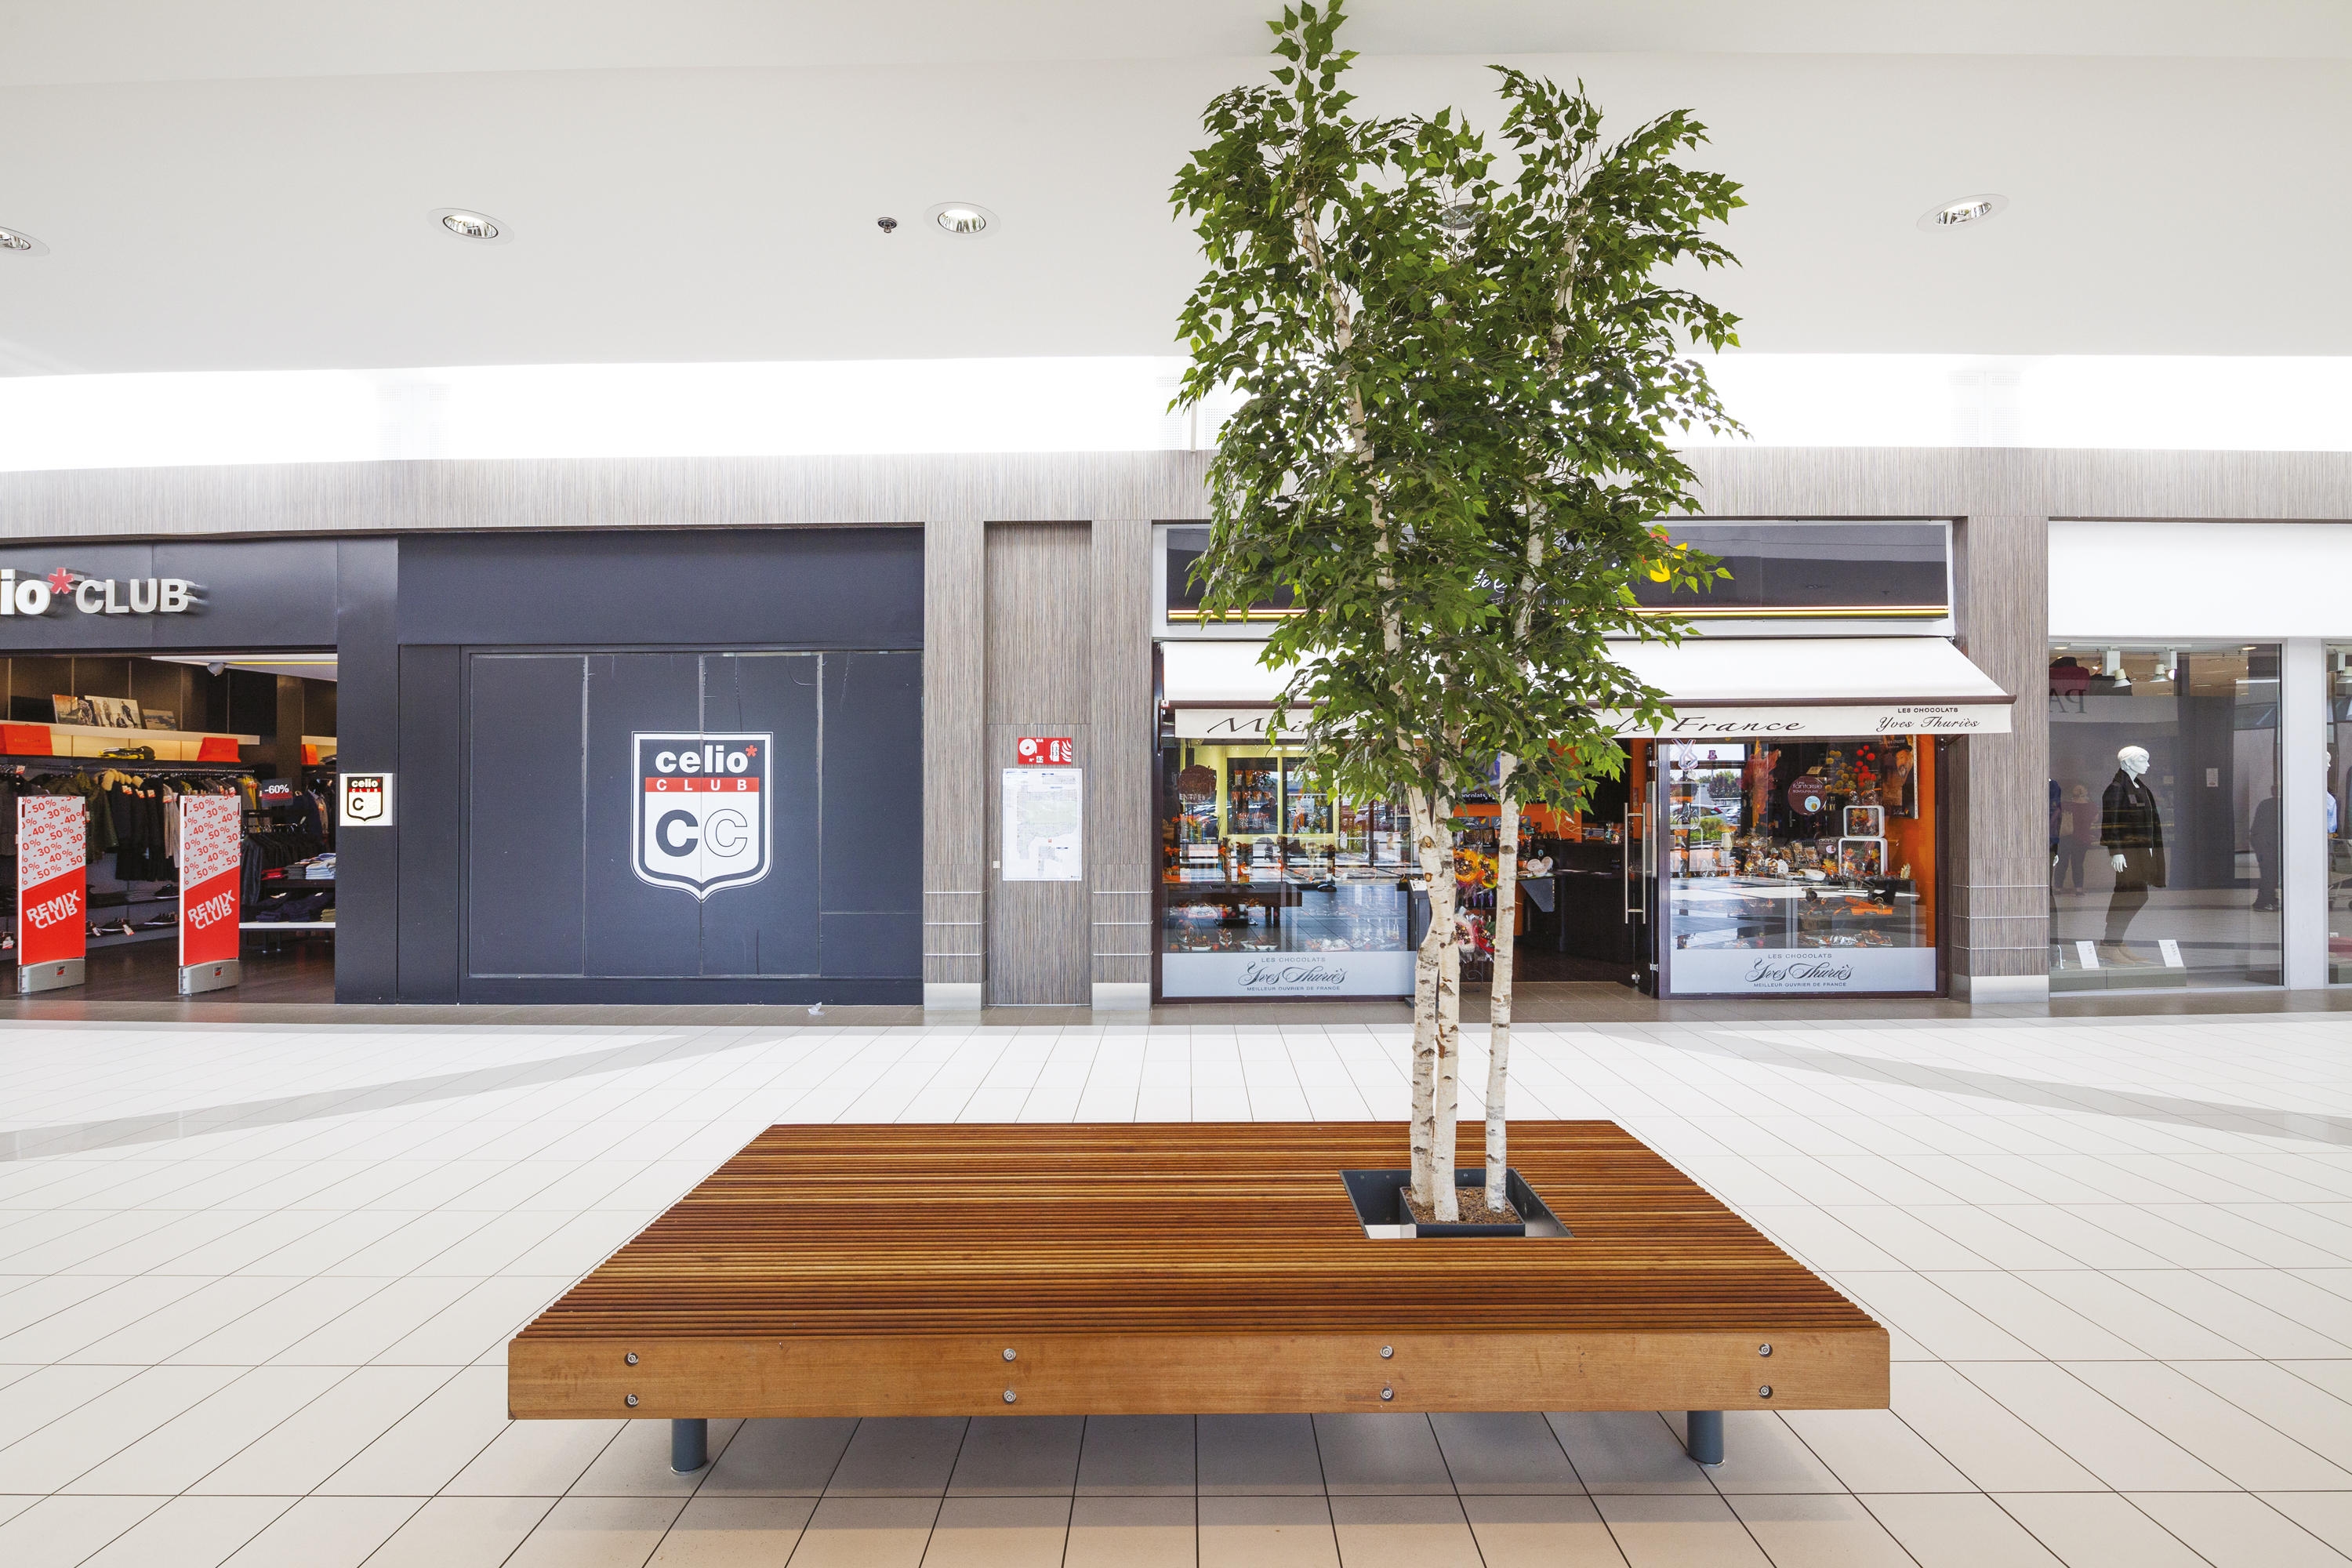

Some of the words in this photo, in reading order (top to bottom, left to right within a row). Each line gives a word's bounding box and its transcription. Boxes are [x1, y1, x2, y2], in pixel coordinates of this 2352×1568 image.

[75, 578, 189, 614] CLUB
[1671, 716, 1806, 732] France
[1875, 717, 1915, 732] Yves
[1920, 716, 1980, 728] Thuriès
[264, 784, 289, 794] -60%
[656, 779, 747, 791] CLUB
[27, 798, 56, 813] -50%
[43, 804, 71, 819] -30%
[189, 798, 215, 812] -50%
[202, 804, 228, 818] -30%
[28, 822, 56, 837] -40%
[45, 826, 74, 841] -50%
[189, 821, 214, 837] -40%
[205, 826, 230, 840] -50%
[655, 808, 748, 858] CC
[33, 842, 62, 857] -30%
[45, 848, 73, 864] -40%
[194, 841, 219, 857] -30%
[204, 848, 229, 864] -40%
[33, 864, 62, 880] -50%
[193, 863, 218, 880] -50%
[26, 889, 82, 922] REMIX
[187, 889, 236, 923] REMIX
[35, 902, 78, 929] CLUB
[194, 902, 232, 930] CLUB
[1238, 961, 1283, 986] Yves
[1282, 965, 1348, 985] Thuriès
[1745, 957, 1789, 982] Yves
[1788, 961, 1855, 980] Thuriès
